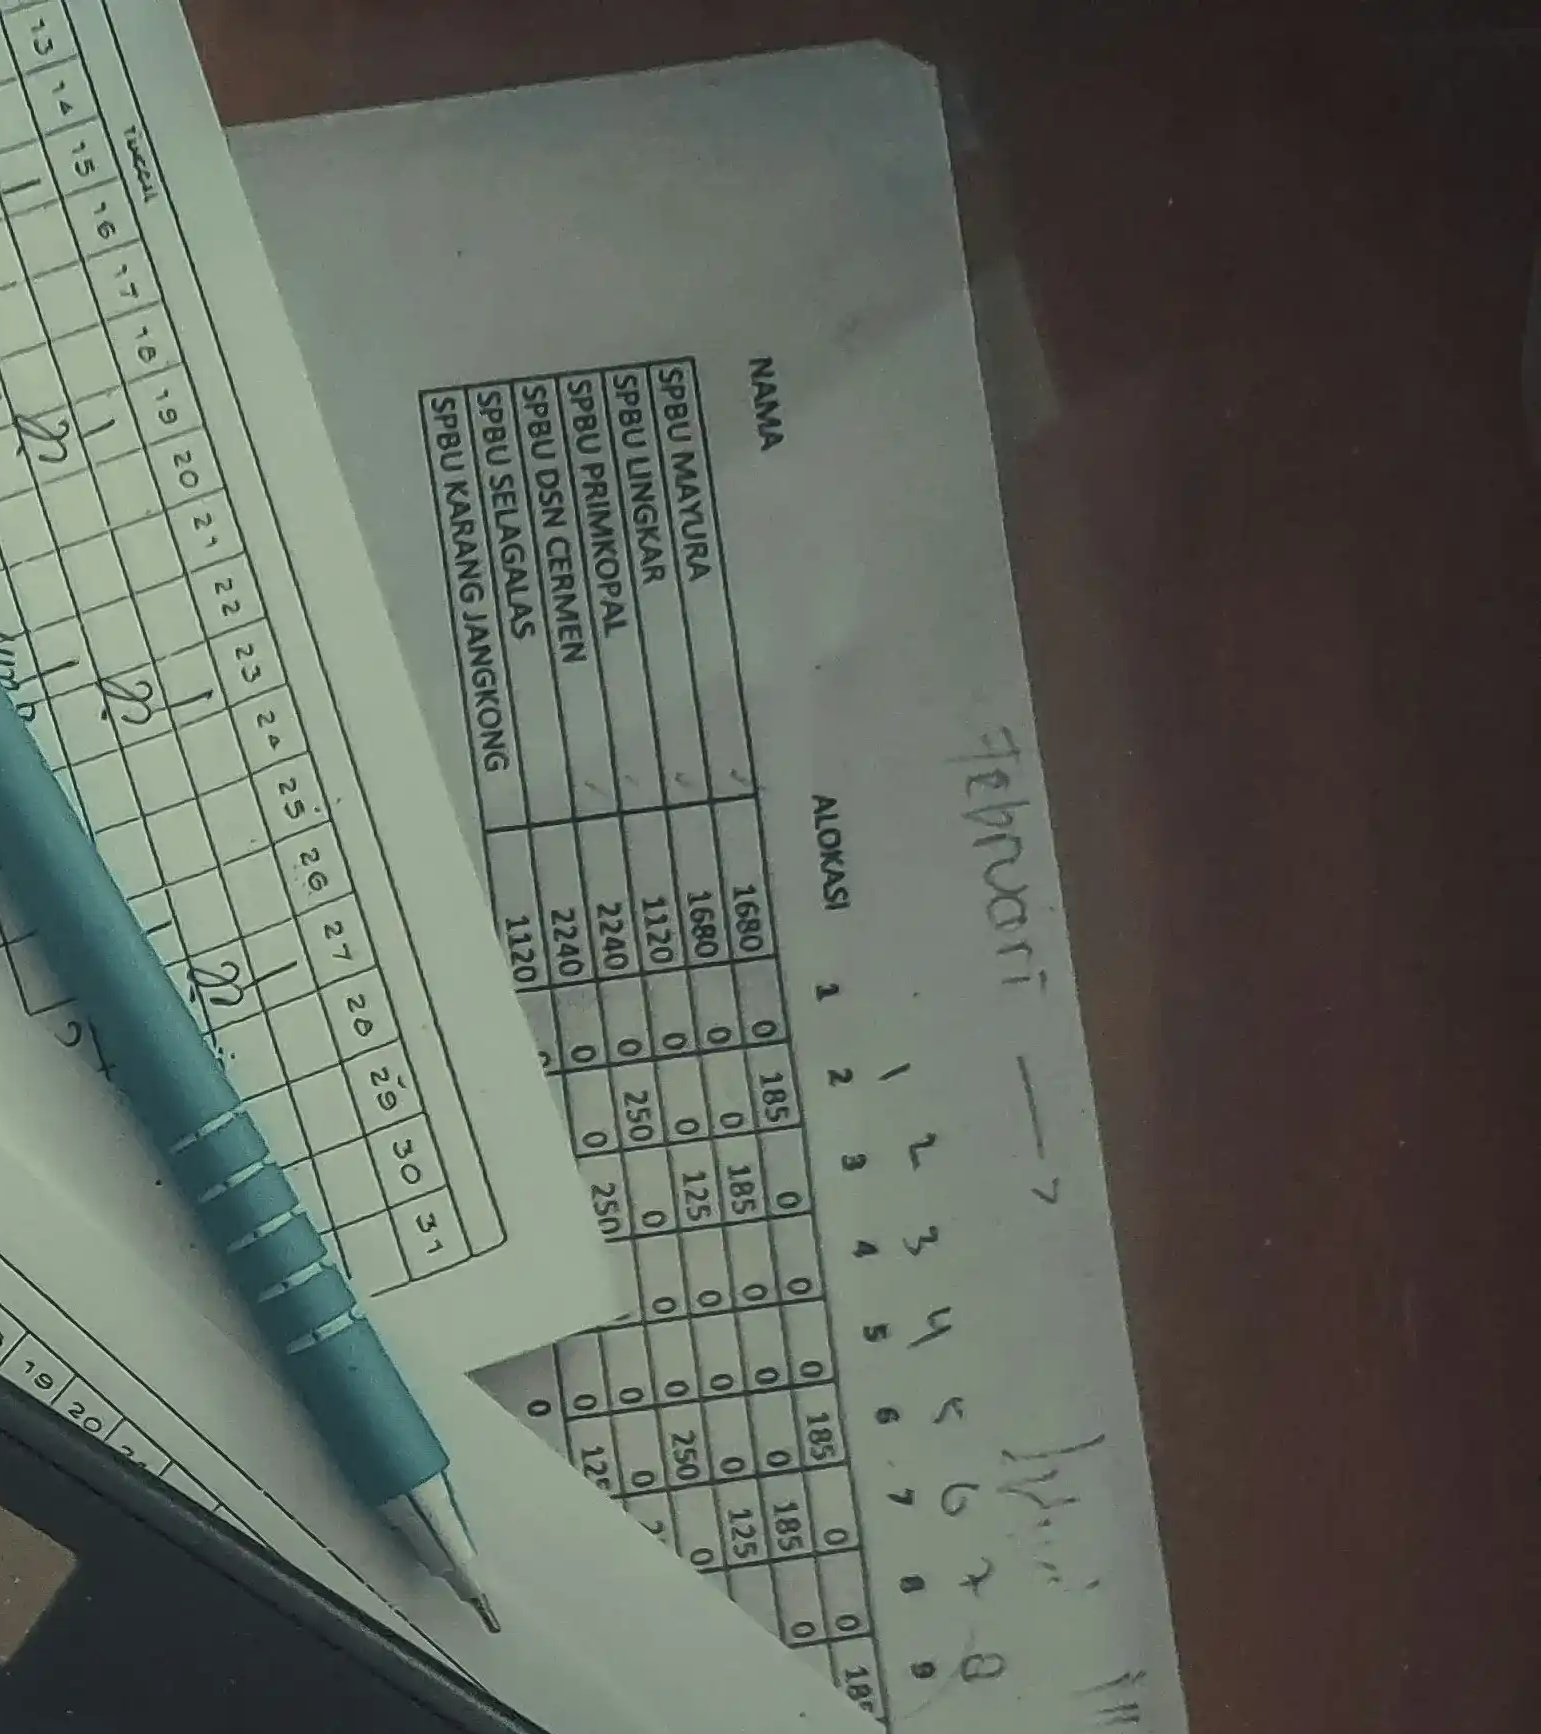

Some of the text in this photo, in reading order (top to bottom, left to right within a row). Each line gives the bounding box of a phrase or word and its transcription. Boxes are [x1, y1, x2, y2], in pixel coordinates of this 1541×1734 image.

[31, 18, 54, 56] 13
[52, 79, 74, 116] 14
[71, 141, 96, 177] 15
[93, 201, 116, 240] 16
[116, 263, 139, 299] 17
[155, 388, 178, 425] 19
[748, 356, 785, 452] NAMA
[173, 449, 199, 489] 20
[611, 371, 667, 584] SPBU LINGKAR
[657, 365, 713, 582] SPBU MAYURA
[193, 512, 218, 548] 21
[475, 389, 536, 639] SPBU SELAGALAS
[520, 383, 587, 664] SPBU DSN CERMEN
[566, 378, 628, 638] SPBU PRIMKOPAL
[214, 577, 241, 617] 22
[430, 395, 510, 773] SPBU KARANG JANGKONG
[234, 643, 262, 683] 23
[278, 777, 306, 820] 25
[299, 847, 329, 892] 26
[811, 794, 852, 911] ALOKASI
[323, 920, 353, 961] 27
[550, 907, 585, 977] 2240
[596, 902, 629, 971] 2240
[641, 895, 674, 964] 1120
[686, 890, 719, 959] 1680
[732, 883, 764, 953] 1680
[504, 915, 538, 983] 1120
[370, 1066, 398, 1111] 29
[759, 1072, 790, 1123] 185
[623, 1090, 655, 1142] 250
[392, 1138, 422, 1185] 30
[681, 1170, 712, 1222] 125
[726, 1165, 757, 1215] 185
[415, 1212, 444, 1254] 31
[25, 1360, 54, 1390] 19
[67, 1401, 103, 1433] 20
